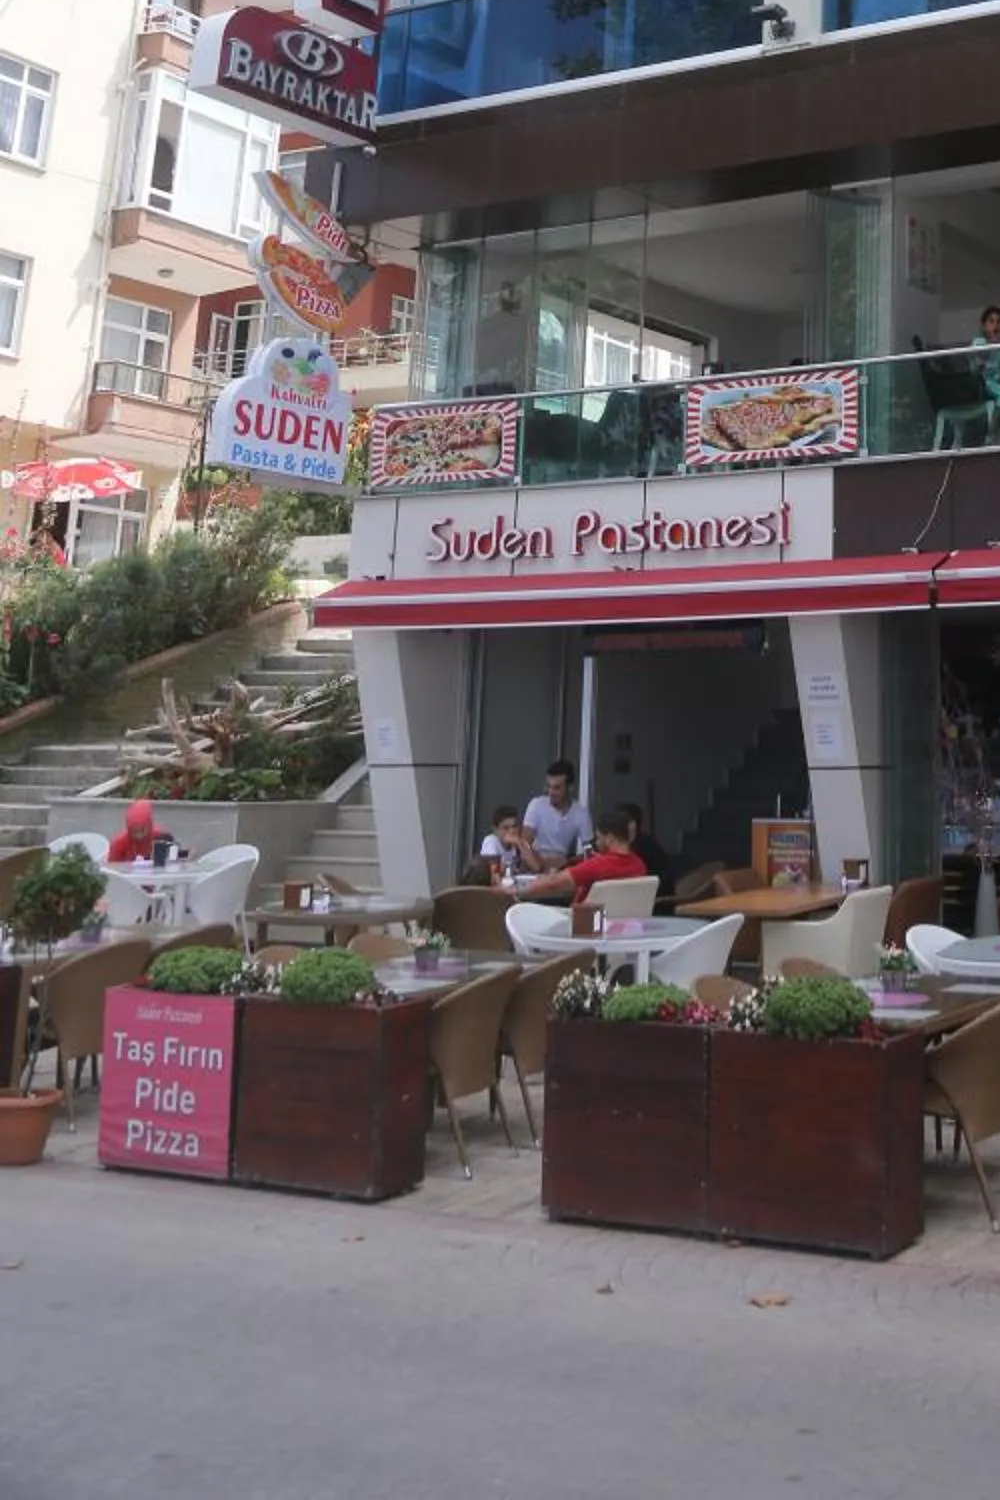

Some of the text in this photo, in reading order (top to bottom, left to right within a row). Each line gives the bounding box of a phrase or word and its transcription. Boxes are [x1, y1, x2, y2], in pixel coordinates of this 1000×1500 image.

[227, 37, 378, 130] BAYRAKTAR
[234, 399, 344, 455] SUDEN
[231, 443, 337, 479] Pasta & Pide
[426, 501, 793, 564] Suden Pastanesi
[112, 1031, 223, 1070] Taş Fırın
[135, 1077, 195, 1114] Pide
[125, 1118, 200, 1157] Pizza
